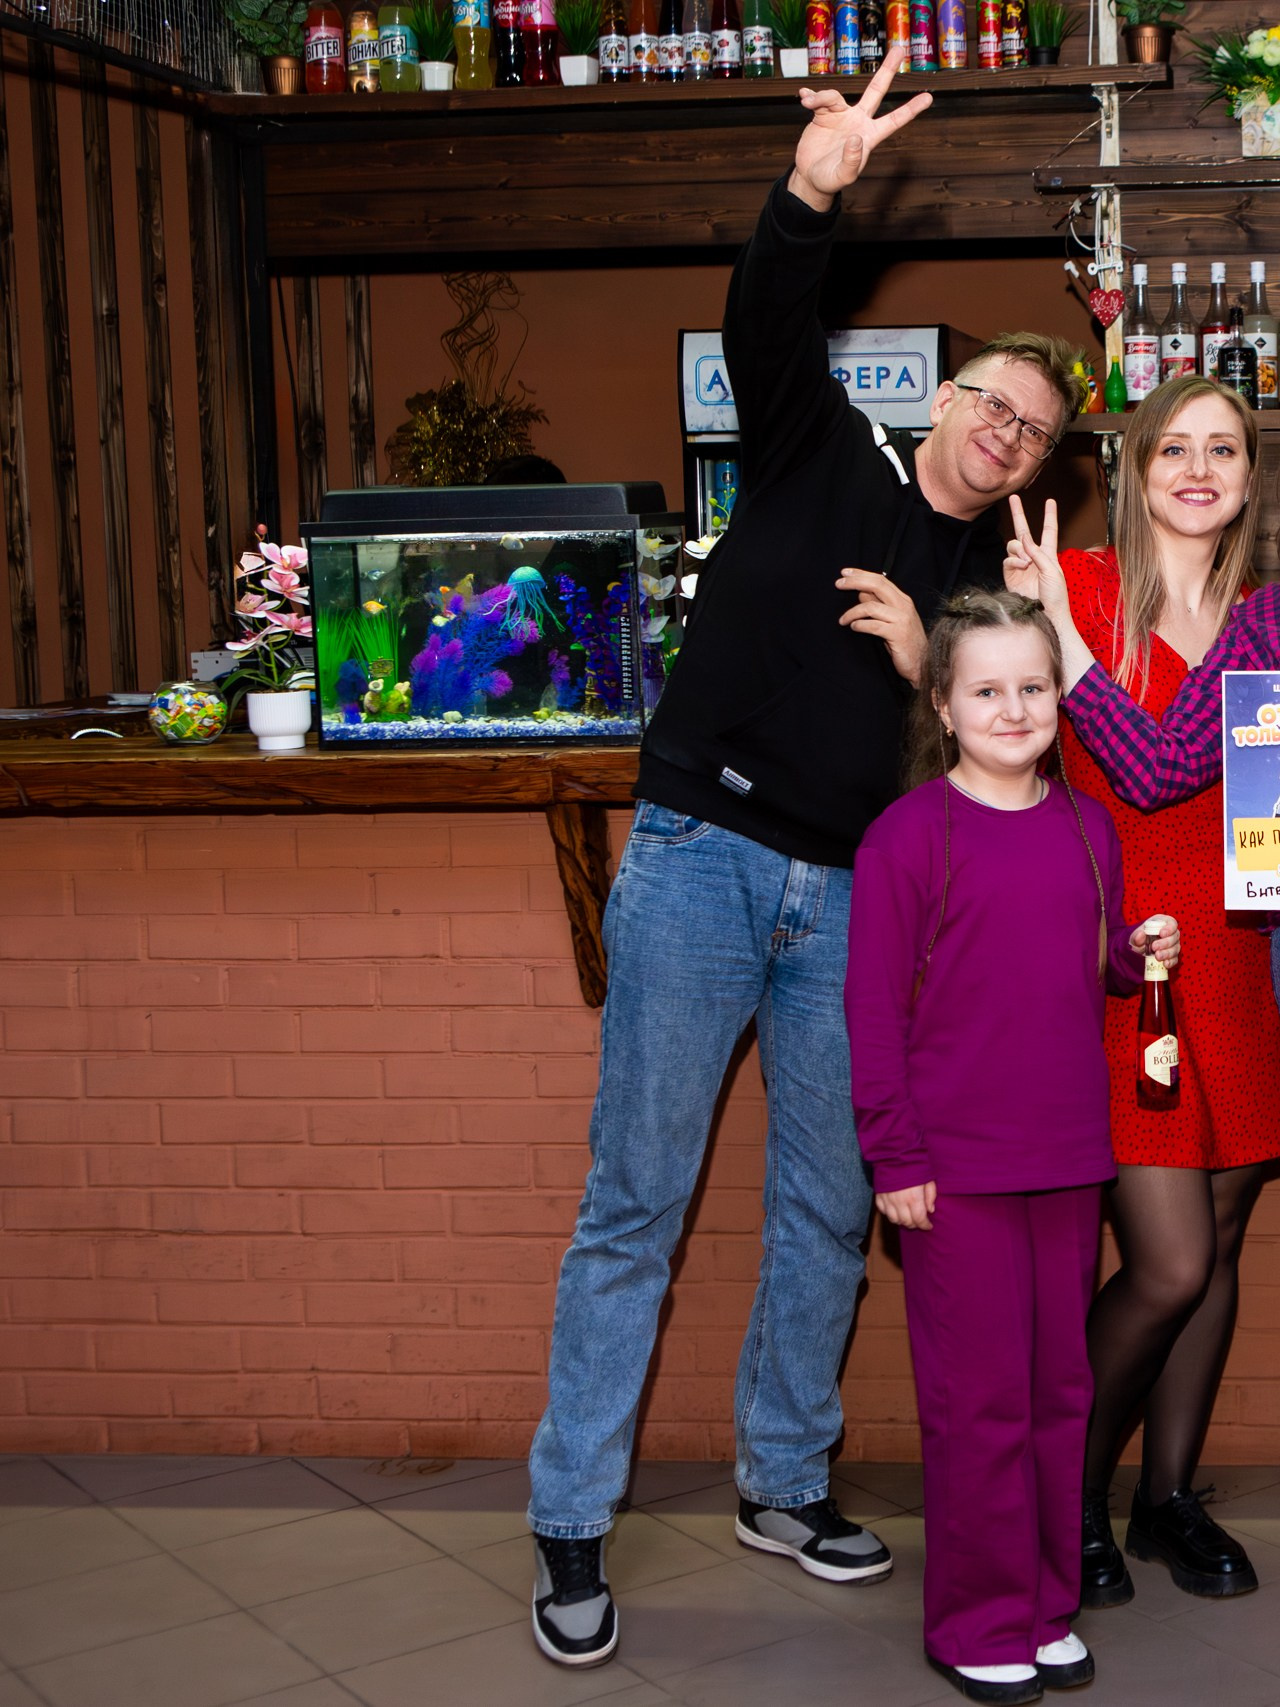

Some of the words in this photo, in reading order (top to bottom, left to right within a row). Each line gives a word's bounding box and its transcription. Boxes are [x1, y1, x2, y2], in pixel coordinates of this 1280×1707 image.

[306, 40, 340, 60] BITTER
[349, 41, 379, 62] ТОНИК
[380, 38, 405, 58] TTER
[838, 49, 859, 58] GORILL
[942, 41, 966, 52] GORILL
[1239, 831, 1265, 849] КАК
